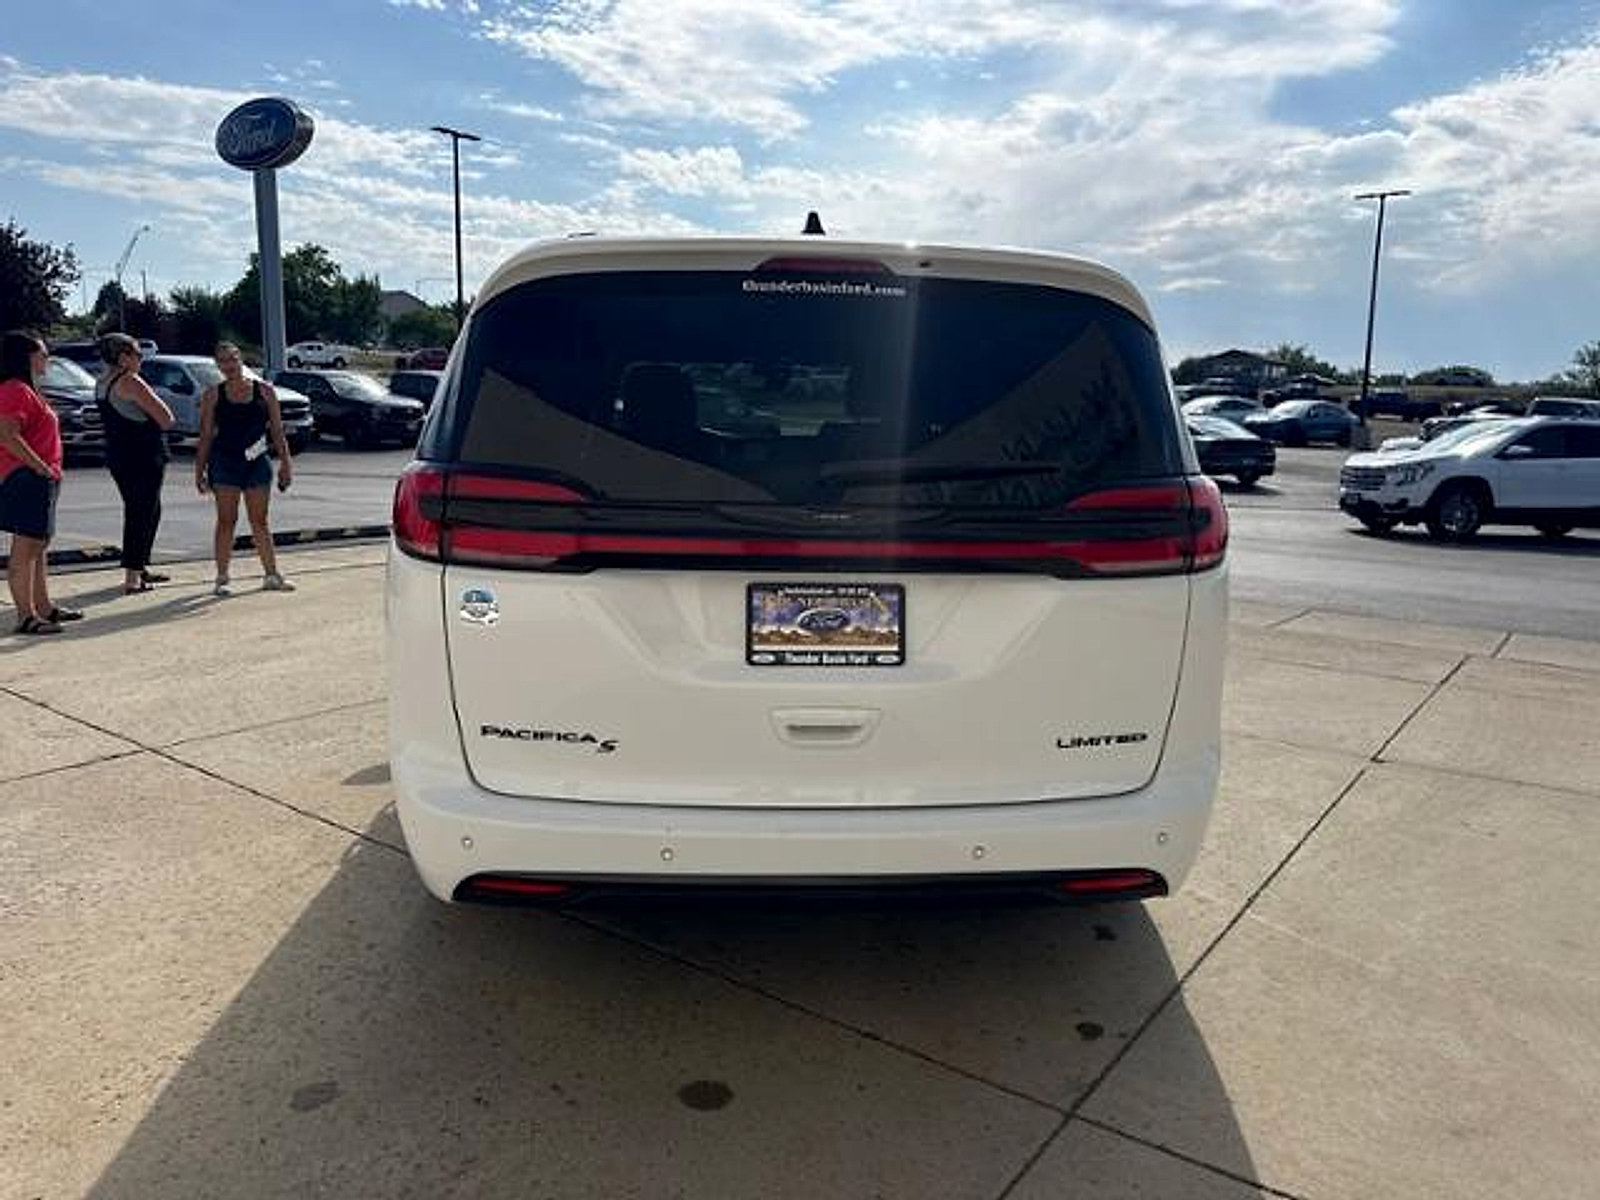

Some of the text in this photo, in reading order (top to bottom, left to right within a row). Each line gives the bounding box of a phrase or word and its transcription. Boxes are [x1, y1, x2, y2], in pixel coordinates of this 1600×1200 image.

[480, 725, 620, 754] PACIFICA S
[1057, 732, 1149, 749] LIMITED
